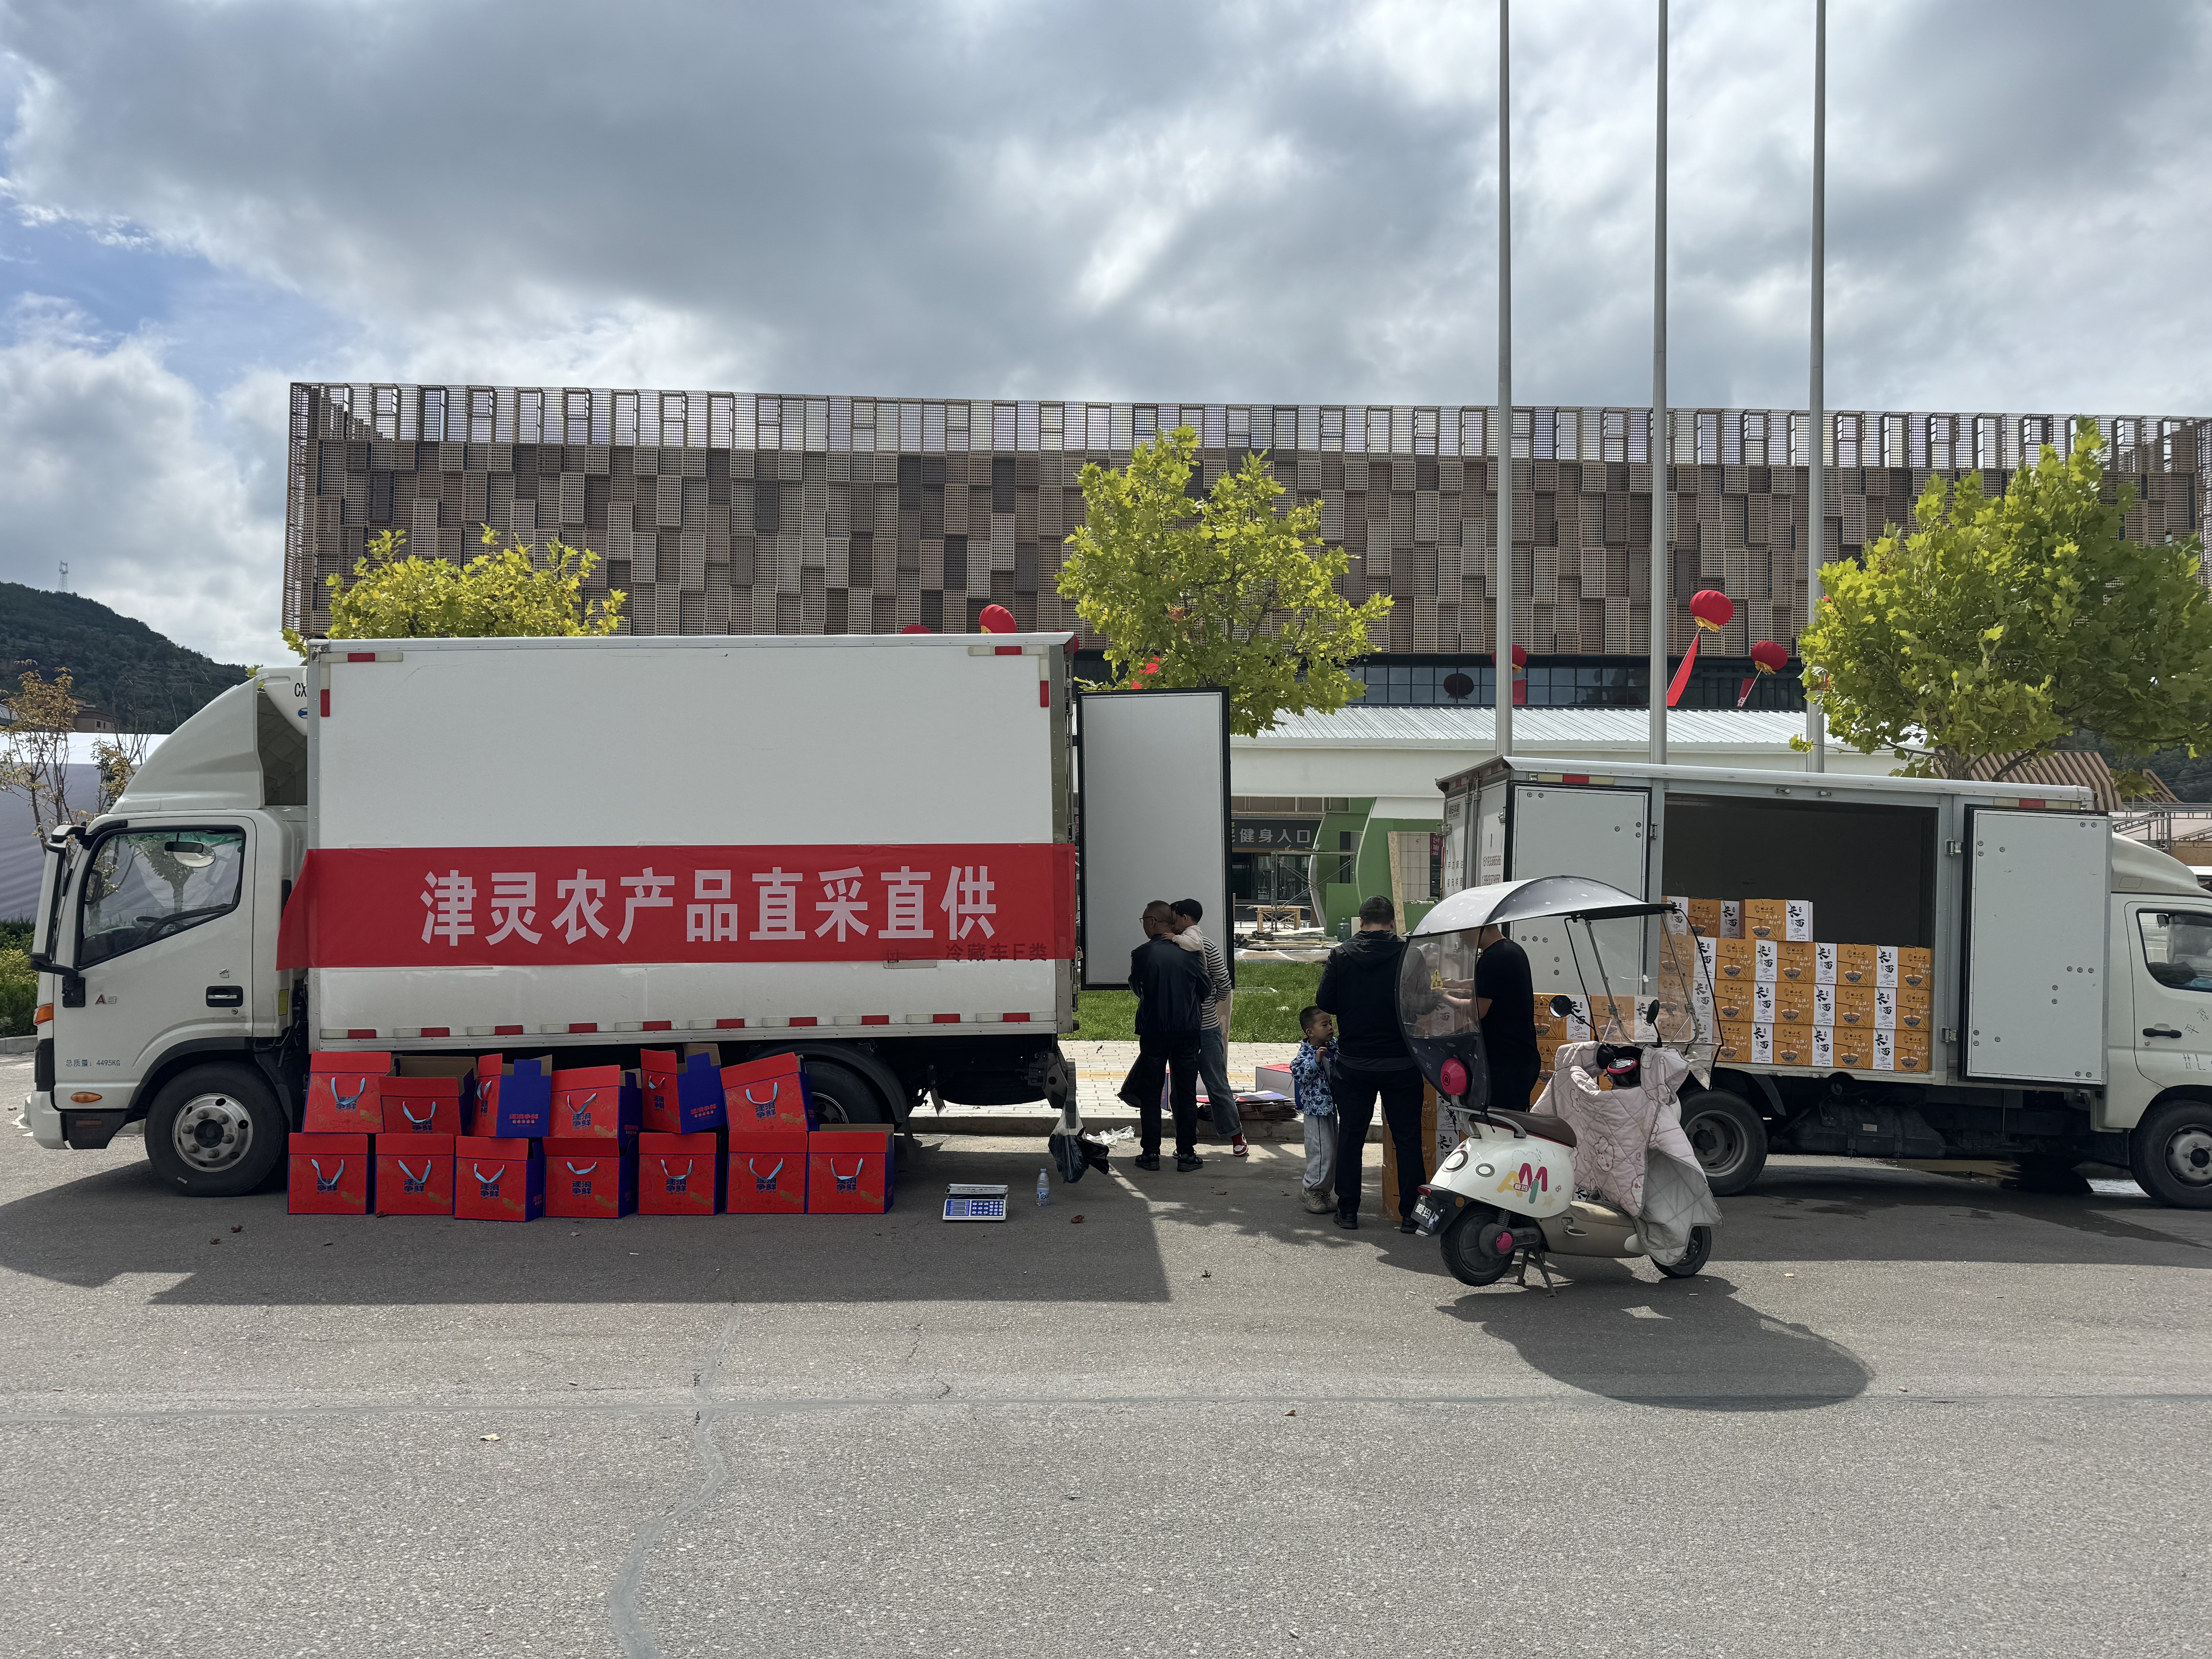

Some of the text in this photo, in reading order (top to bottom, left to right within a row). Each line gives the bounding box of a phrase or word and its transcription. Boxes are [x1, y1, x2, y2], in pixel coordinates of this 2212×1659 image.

[1232, 828, 1310, 843] 健身入口
[420, 866, 996, 946] 津灵农产品直采直供
[946, 943, 1047, 962] 冷藏车F类
[1415, 1203, 1431, 1219] 爱玛
